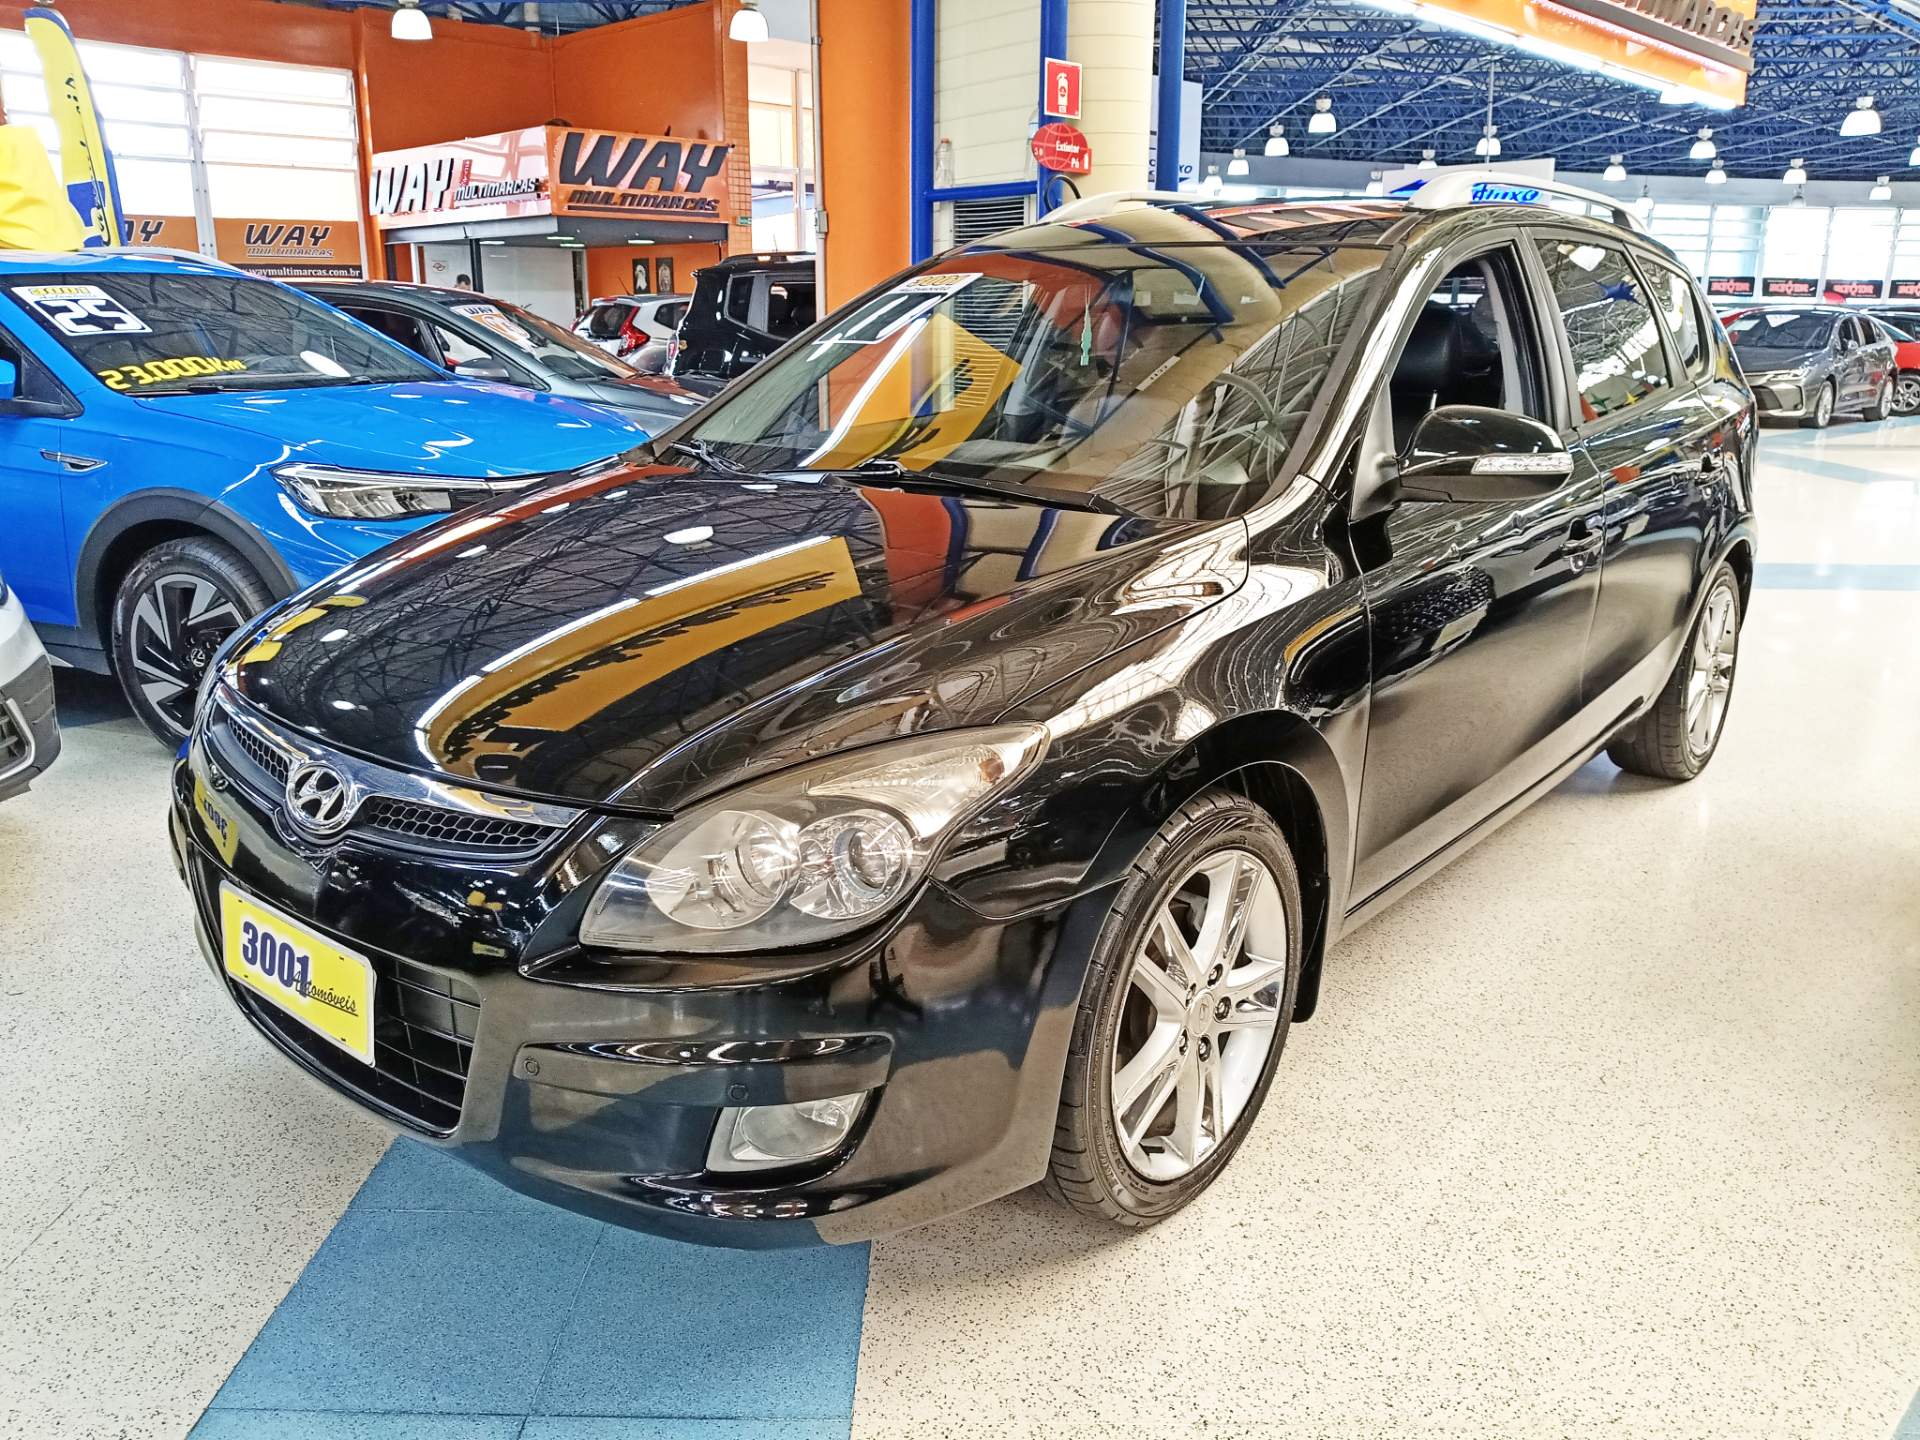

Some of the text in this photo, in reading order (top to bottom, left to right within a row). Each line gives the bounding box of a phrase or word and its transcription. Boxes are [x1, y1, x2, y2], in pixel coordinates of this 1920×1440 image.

[559, 131, 730, 193] WAY
[369, 157, 455, 215] WAY
[454, 178, 539, 202] MULTIMARCAS
[567, 189, 721, 212] MULTIMARCAS
[244, 223, 332, 247] WAY
[37, 299, 146, 332] 25
[242, 920, 312, 999] 3001
[292, 969, 359, 1013] Automóveis
